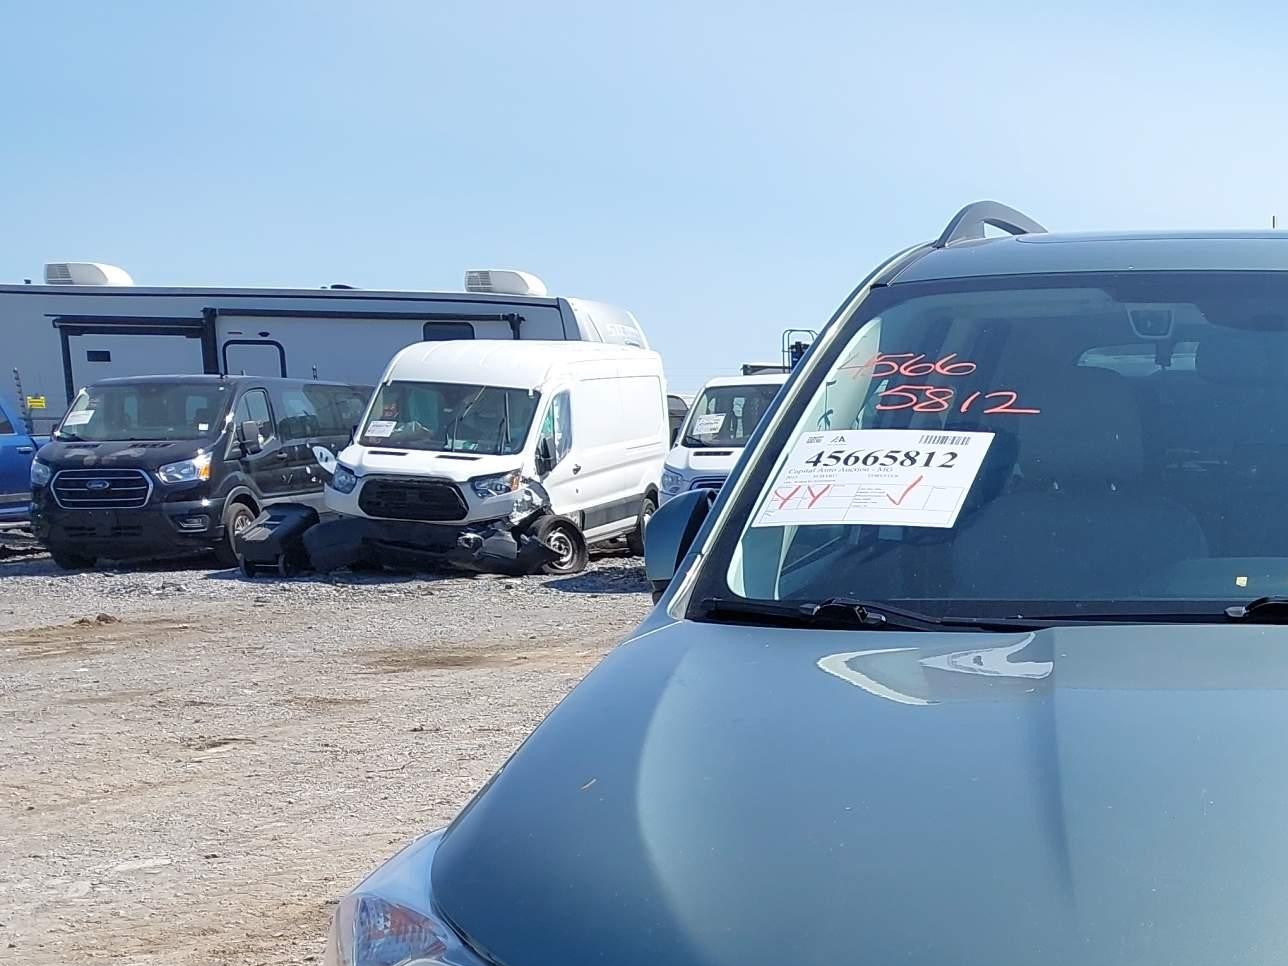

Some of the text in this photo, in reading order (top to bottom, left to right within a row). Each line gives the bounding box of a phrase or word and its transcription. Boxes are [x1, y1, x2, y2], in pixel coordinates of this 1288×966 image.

[837, 352, 977, 379] 4566
[875, 384, 1041, 414] 5812
[804, 448, 959, 469] 45665812
